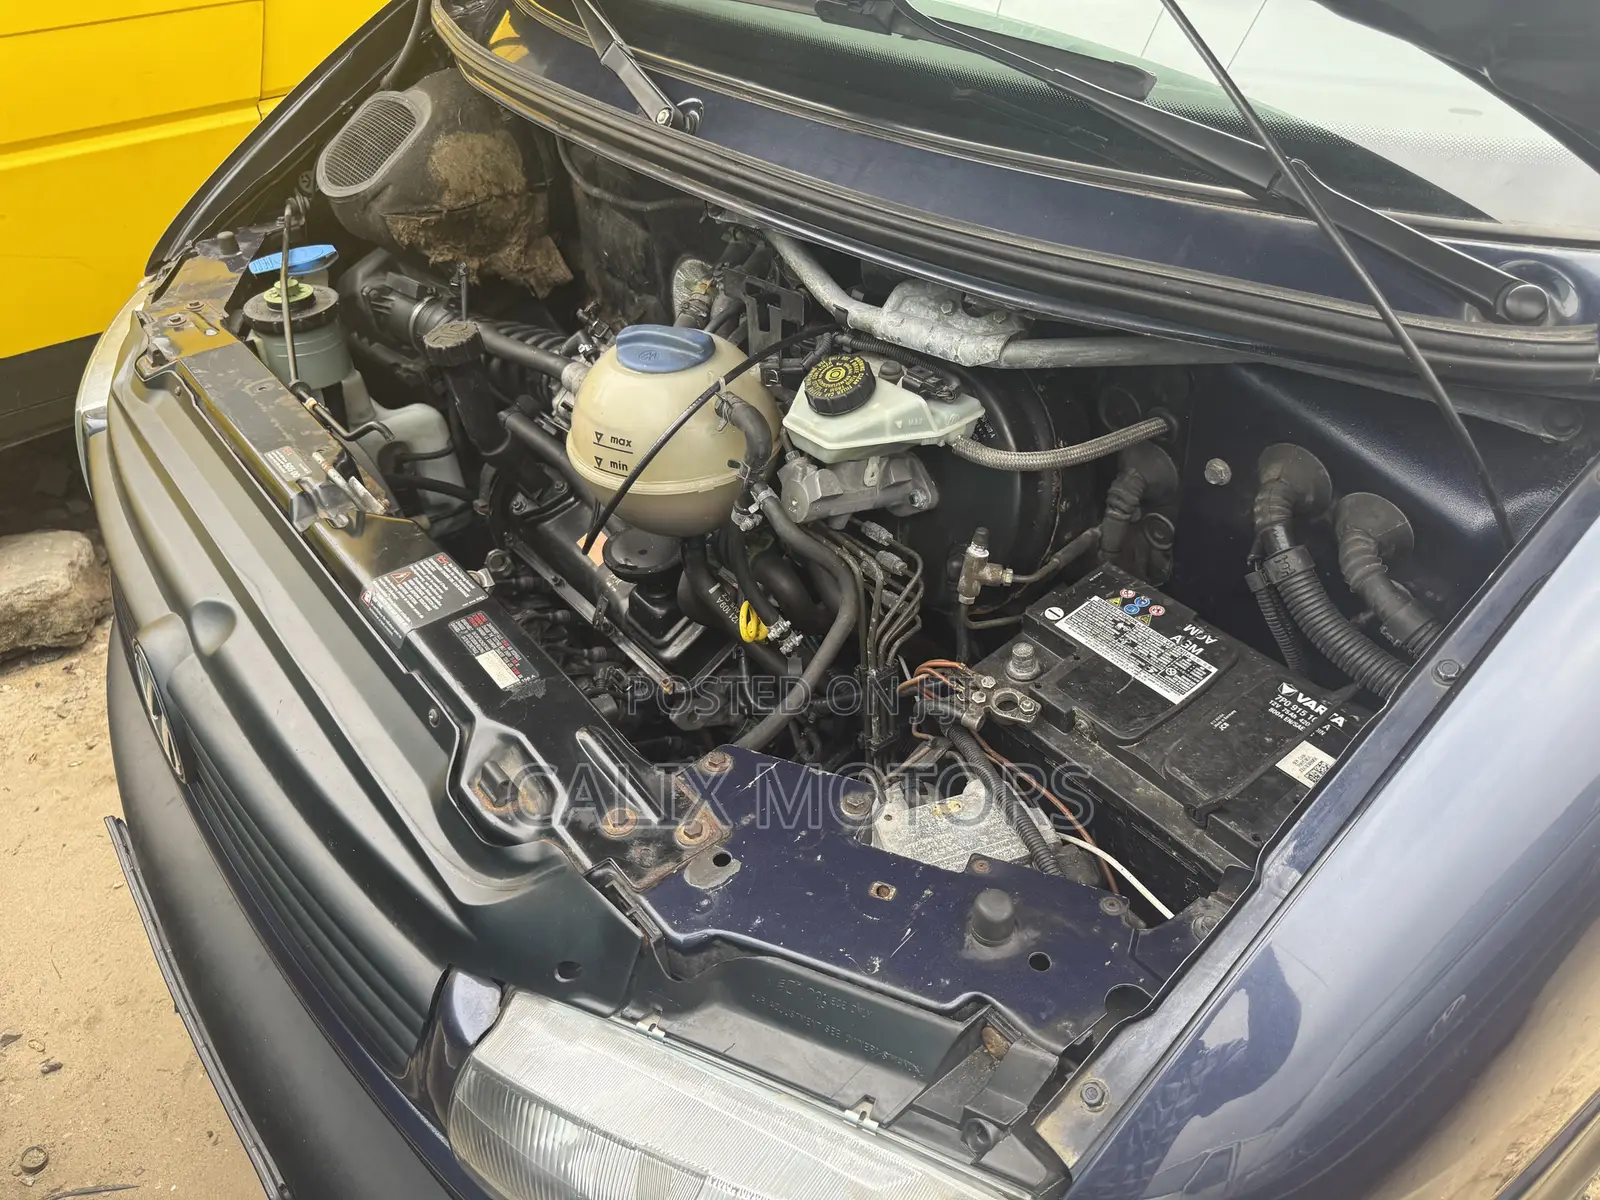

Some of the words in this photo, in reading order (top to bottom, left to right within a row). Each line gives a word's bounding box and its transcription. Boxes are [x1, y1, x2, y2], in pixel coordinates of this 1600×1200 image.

[611, 436, 632, 448] max
[610, 460, 628, 472] min
[1290, 703, 1308, 718] 915
